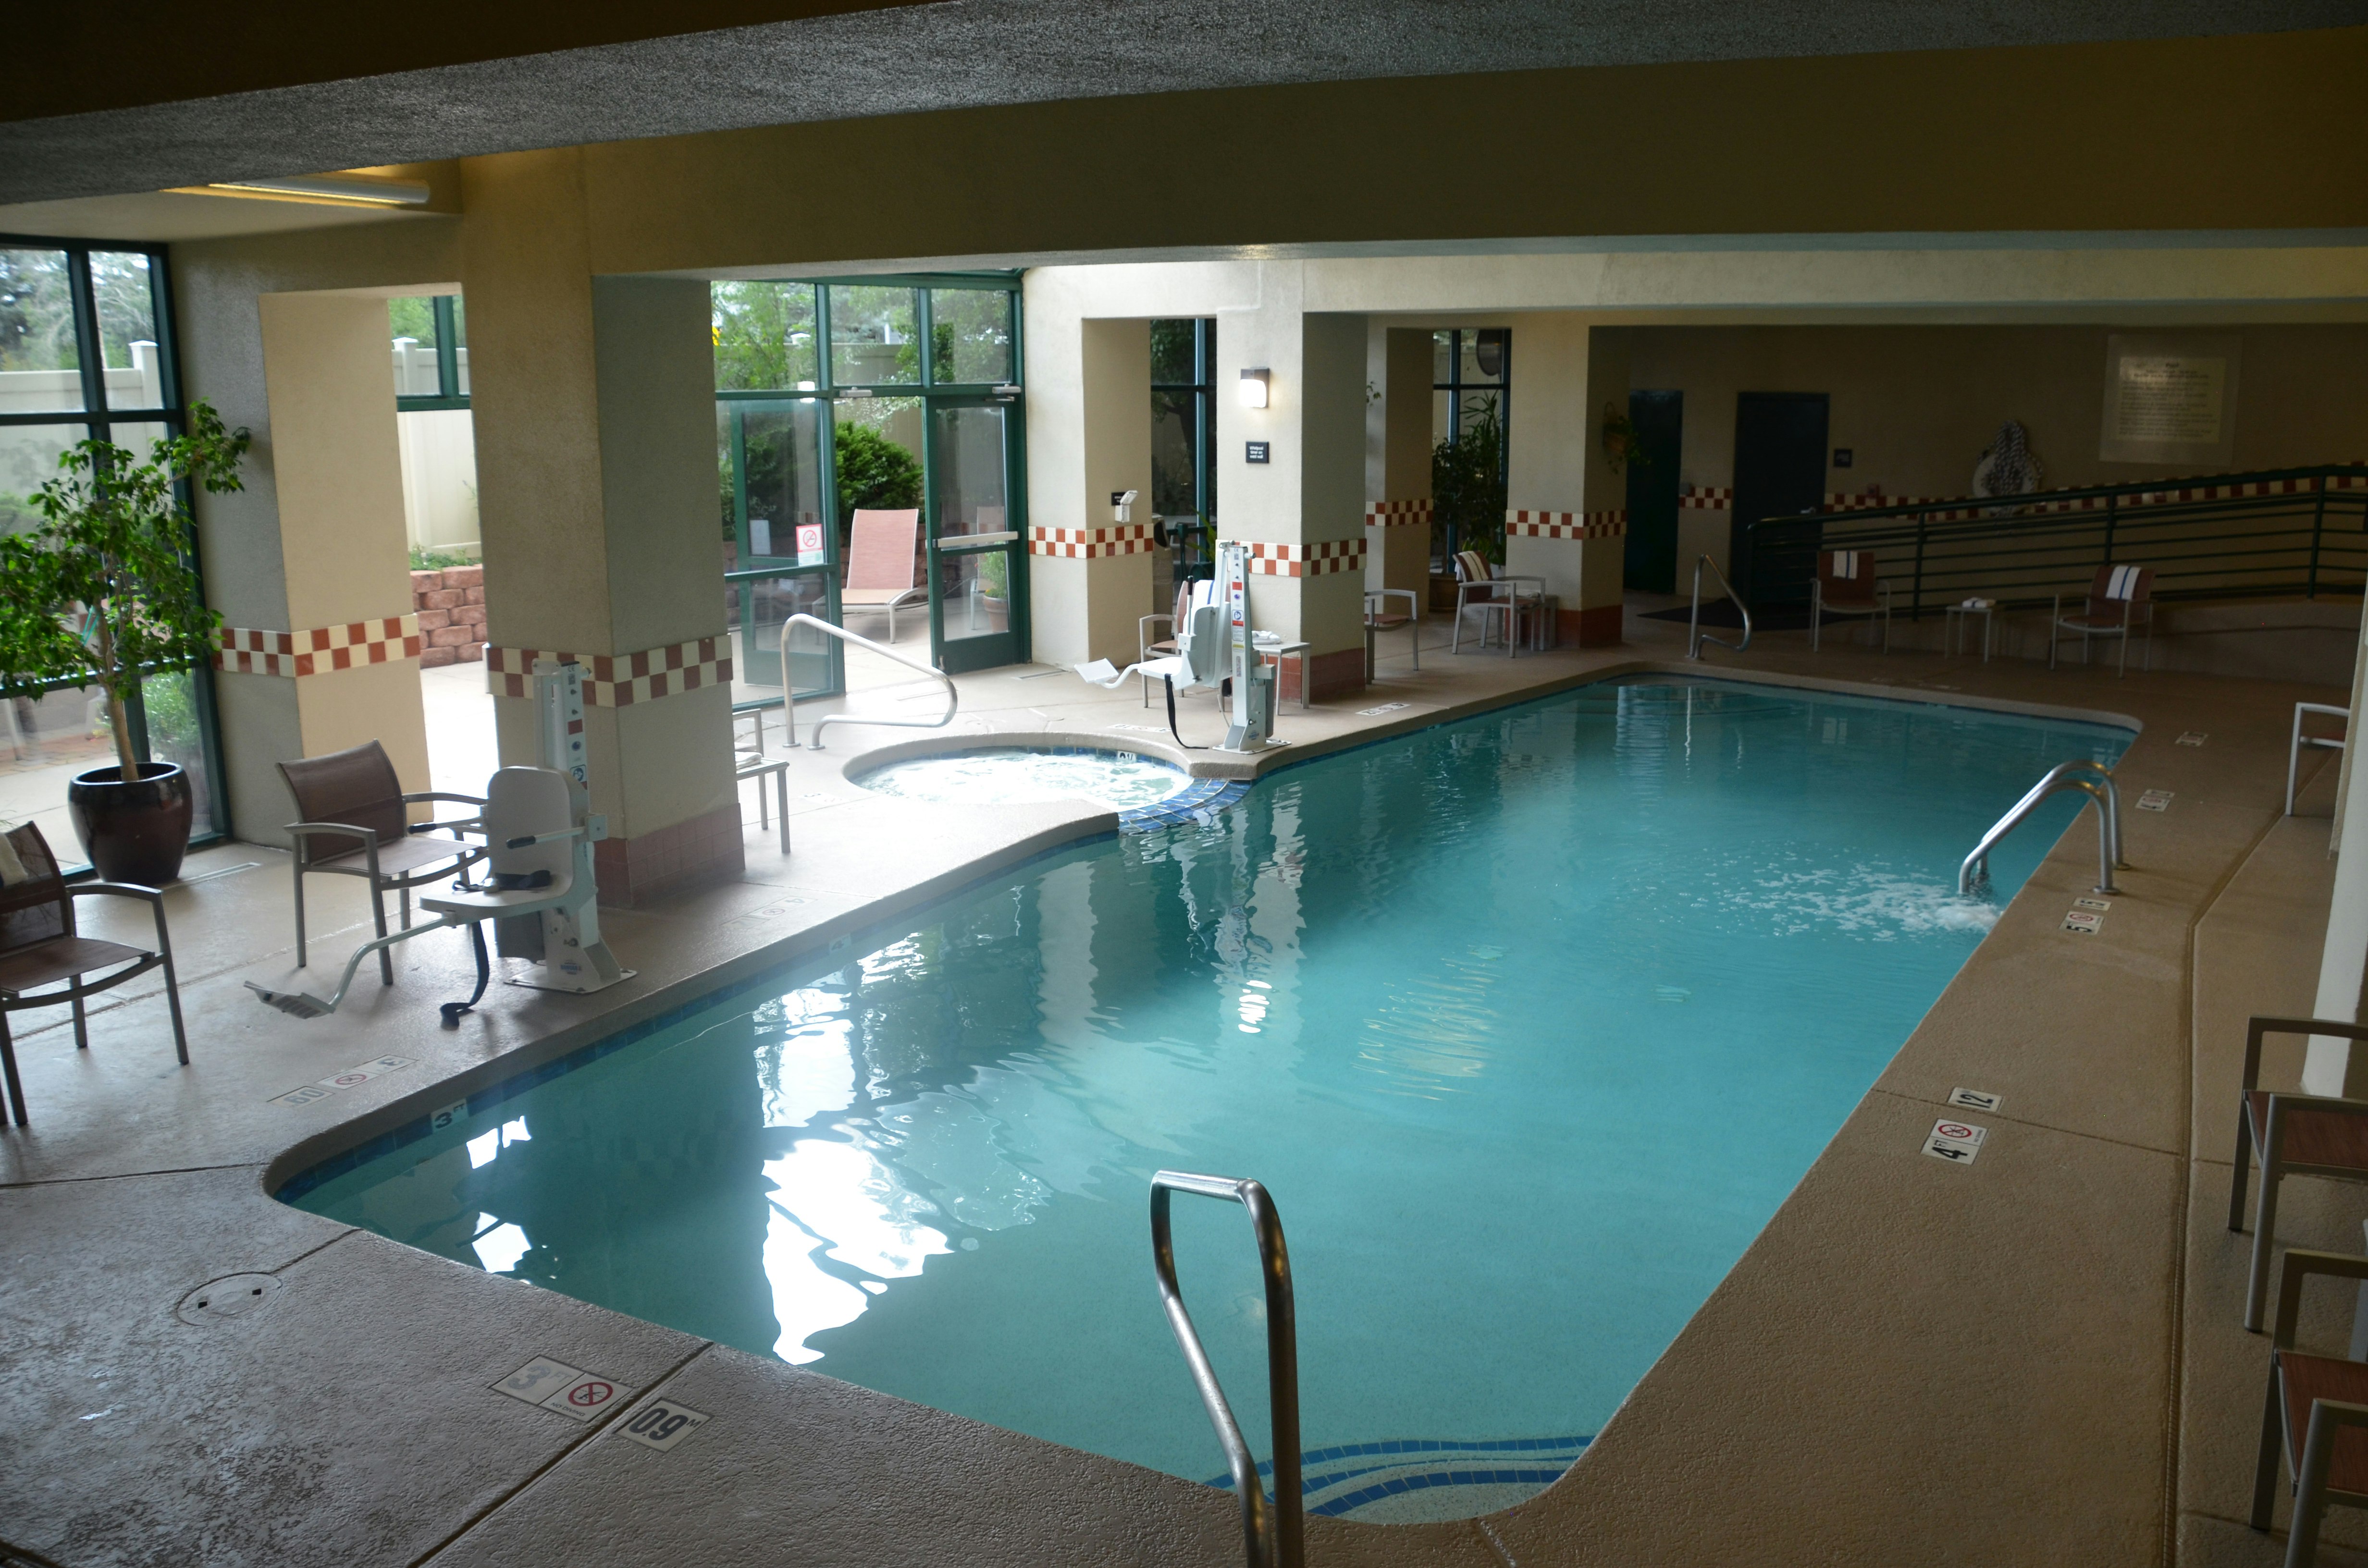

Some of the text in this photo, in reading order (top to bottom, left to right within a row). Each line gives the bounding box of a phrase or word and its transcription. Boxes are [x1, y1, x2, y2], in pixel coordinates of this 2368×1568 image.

[434, 1103, 465, 1129] 3 FT
[1932, 1147, 1968, 1160] 4
[507, 1365, 573, 1390] 3 FT
[551, 1401, 586, 1418] NO DIVING
[687, 1419, 701, 1429] M
